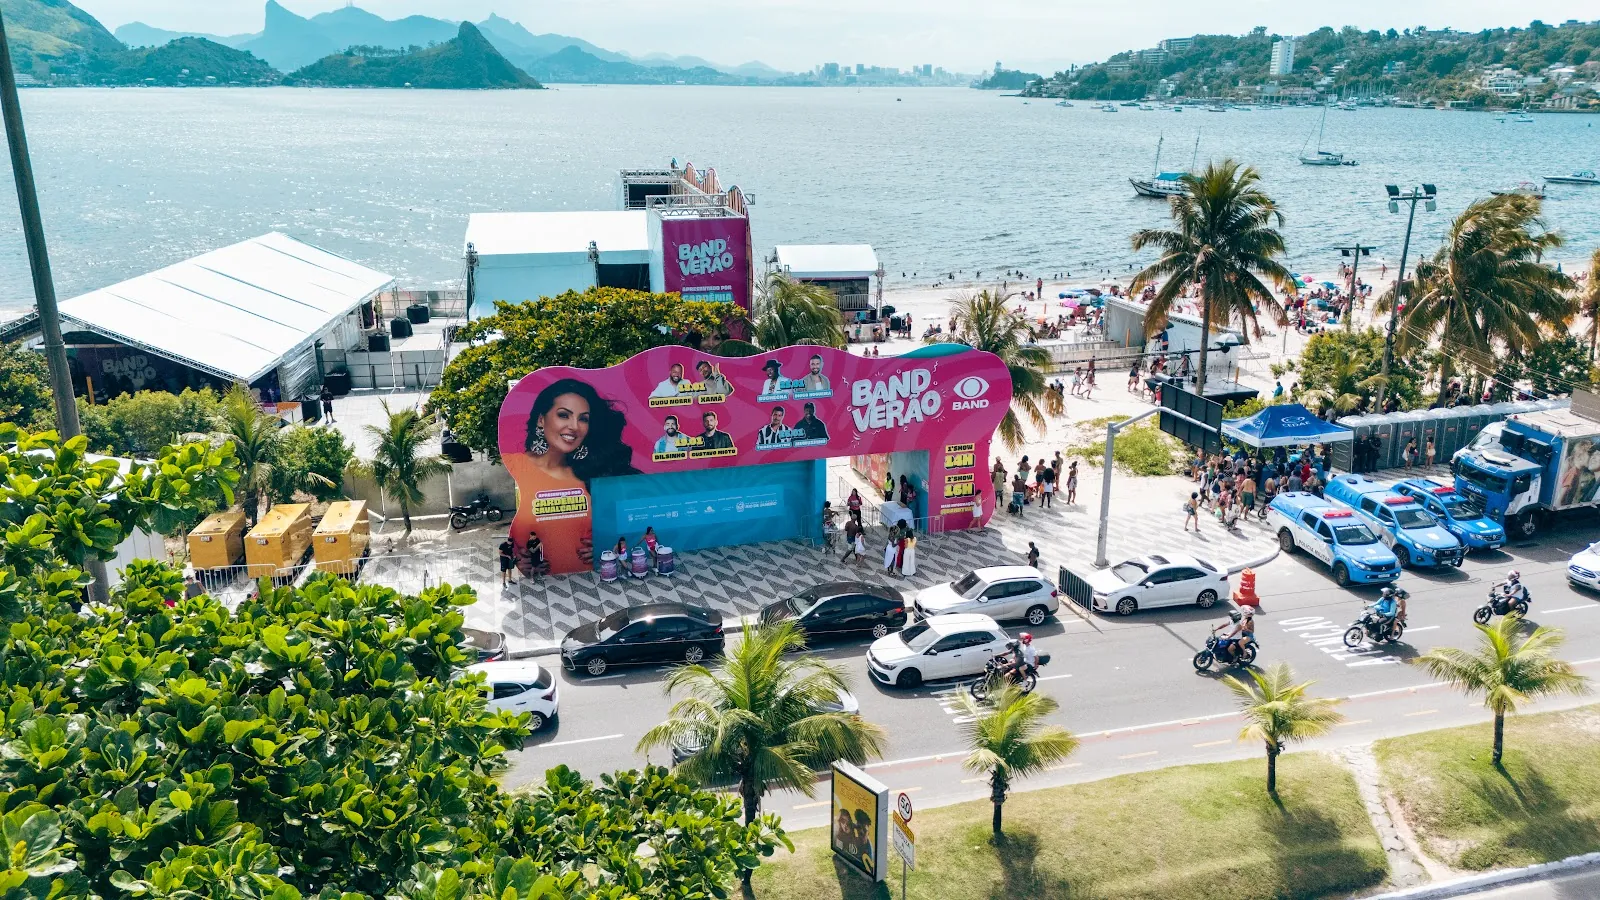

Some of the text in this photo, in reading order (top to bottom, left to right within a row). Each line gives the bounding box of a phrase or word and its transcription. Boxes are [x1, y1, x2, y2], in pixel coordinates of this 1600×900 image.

[678, 239, 727, 260] BAND
[678, 252, 734, 276] VERÃO
[682, 292, 733, 302] GARDÊNIA
[102, 354, 148, 374] BAND
[851, 368, 932, 407] BAND
[851, 389, 942, 433] VERÃO
[952, 399, 990, 411] BAND
[1282, 420, 1311, 428] CEDAE
[944, 453, 975, 469] 14H
[944, 483, 975, 499] 16H
[534, 503, 588, 515] CAVALCANTI
[1314, 550, 1331, 563] MILITAR
[900, 796, 910, 814] 50
